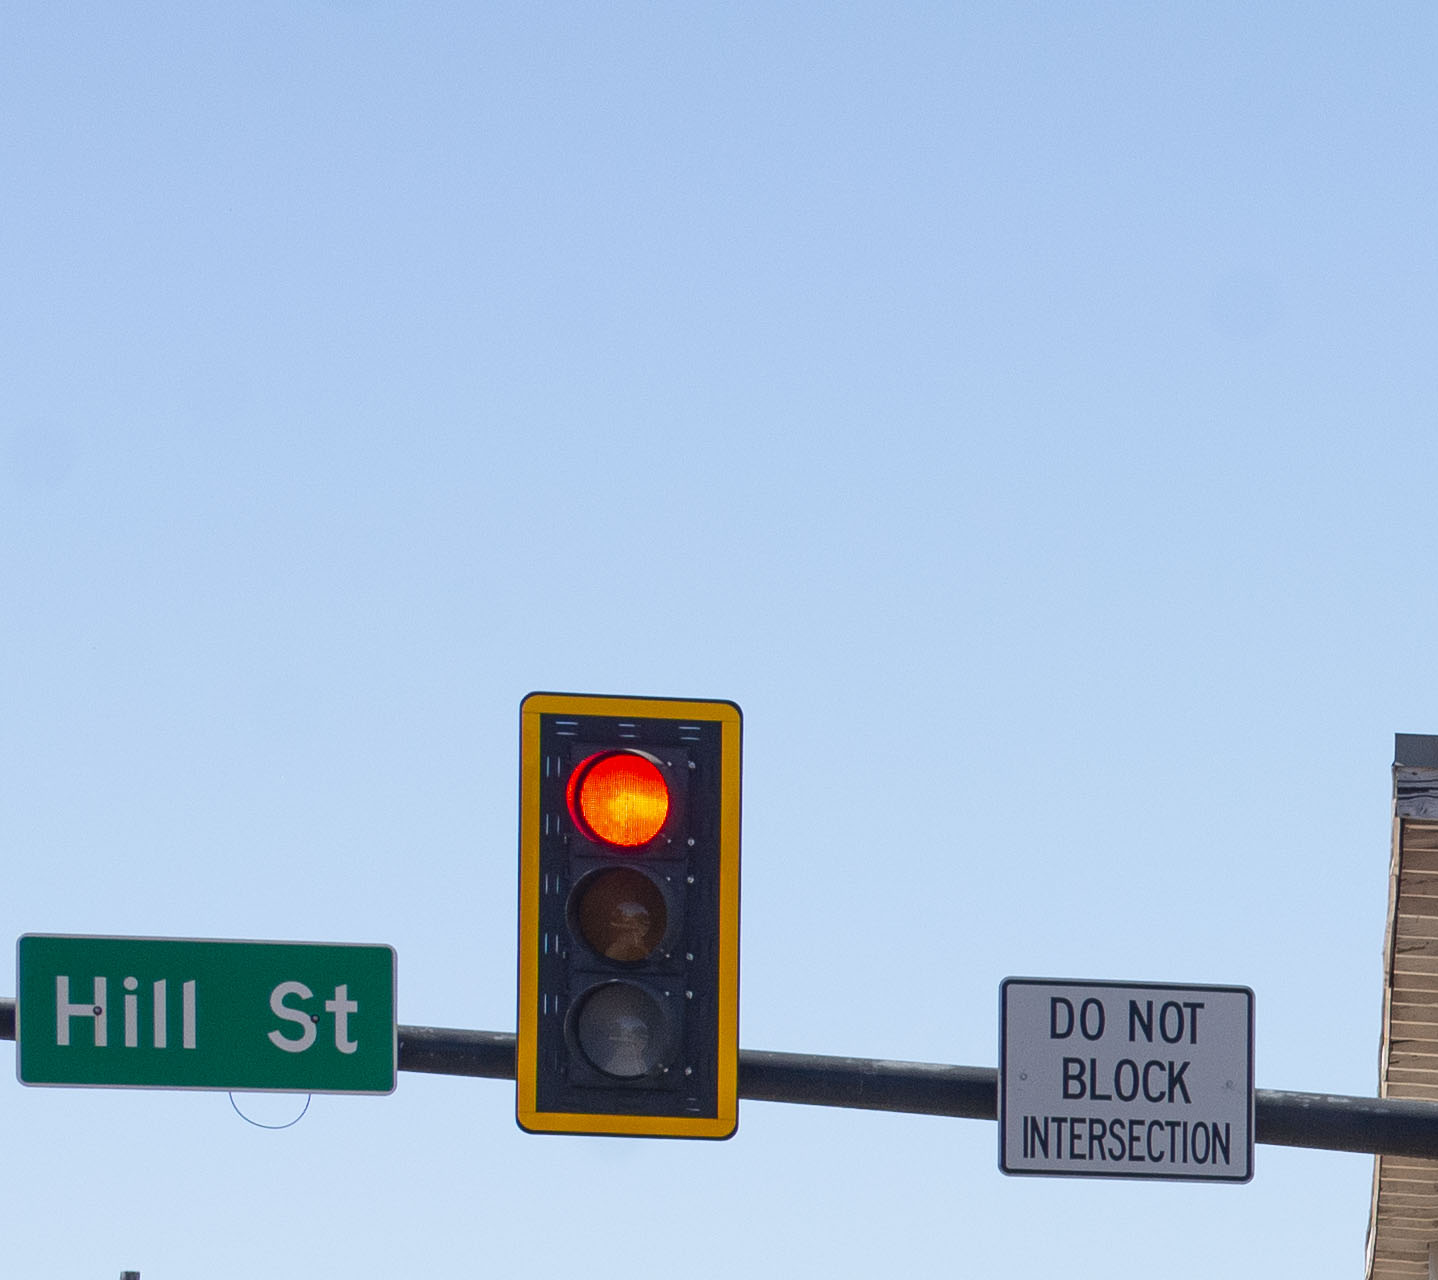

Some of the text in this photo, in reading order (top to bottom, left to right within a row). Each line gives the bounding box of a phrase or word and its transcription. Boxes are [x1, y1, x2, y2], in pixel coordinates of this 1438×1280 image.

[57, 976, 358, 1053] Hill St
[1050, 996, 1205, 1044] DO NOT
[1062, 1056, 1192, 1104] BLOCK
[1022, 1115, 1231, 1165] INTERSECTION
